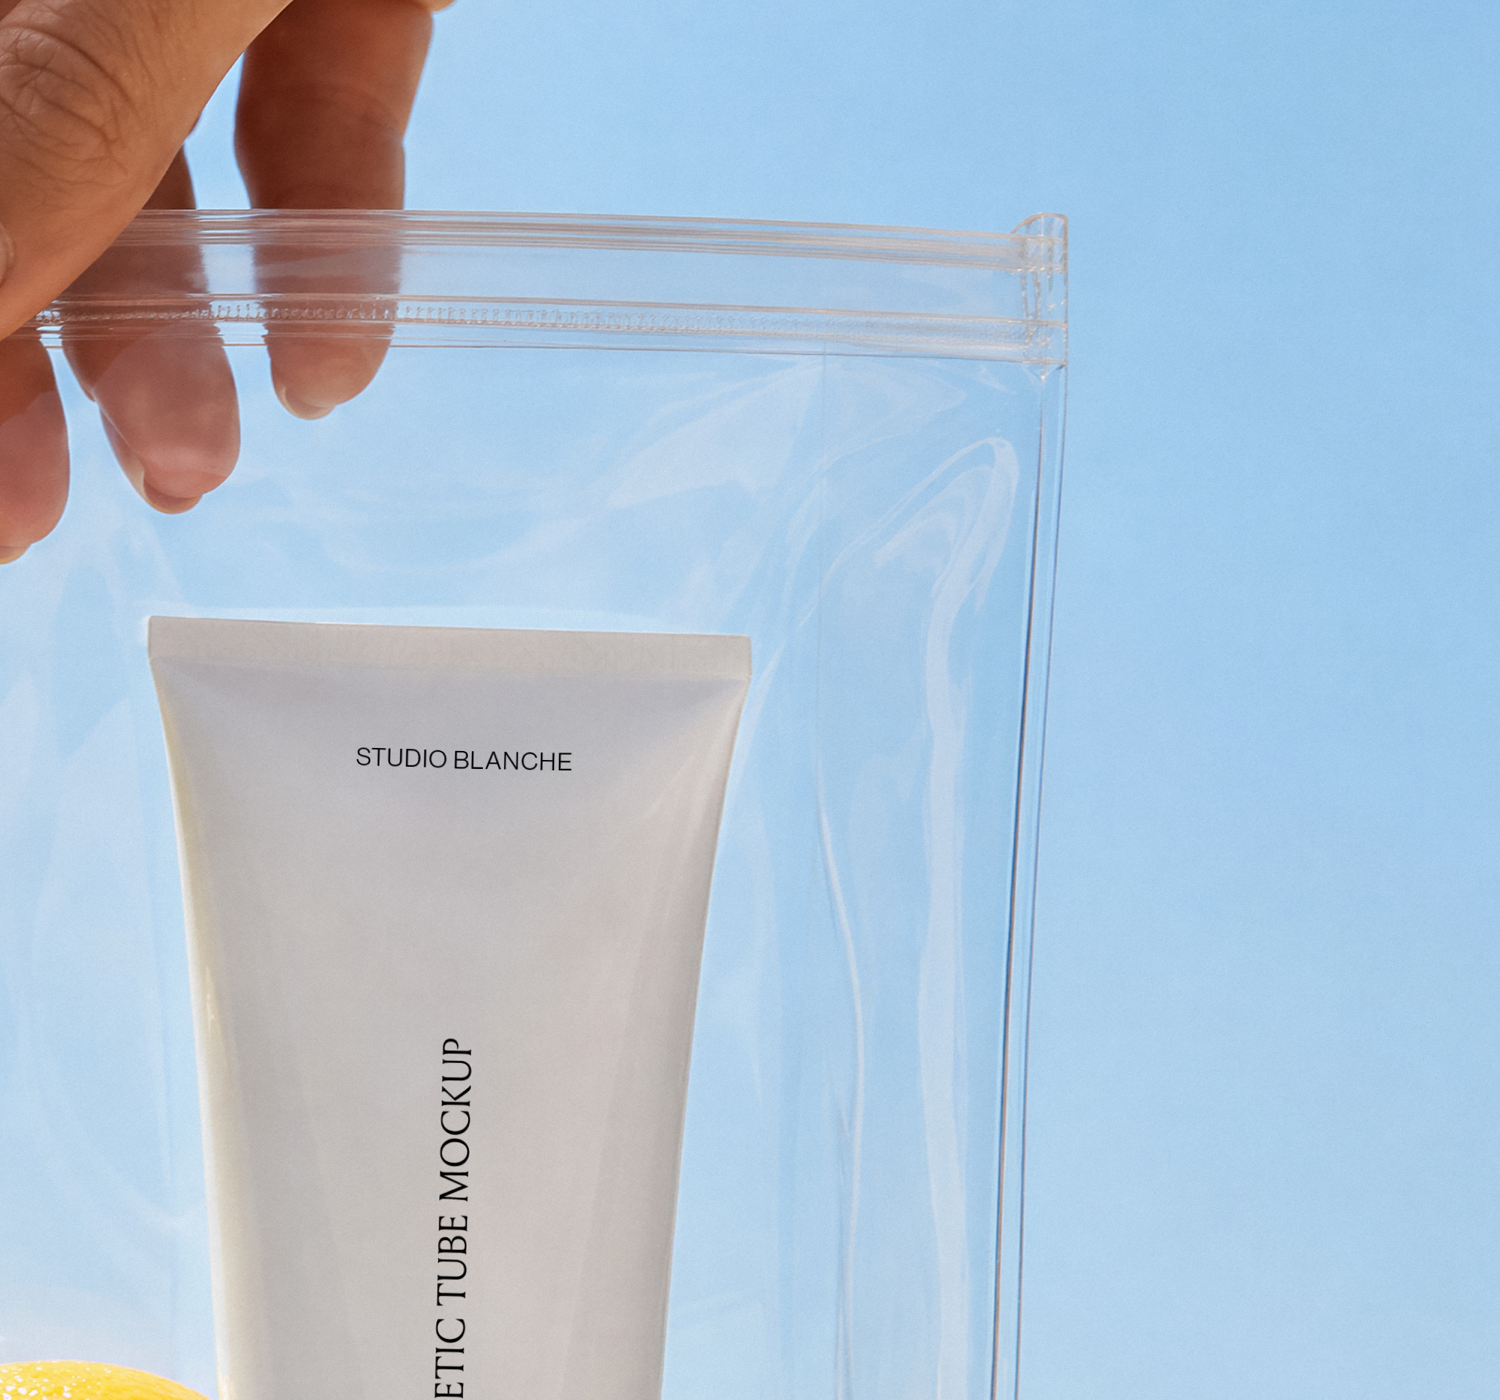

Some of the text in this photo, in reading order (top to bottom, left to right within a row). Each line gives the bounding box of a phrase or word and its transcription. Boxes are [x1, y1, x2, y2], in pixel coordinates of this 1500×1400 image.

[356, 747, 573, 771] STUDIO BLANCHE
[438, 1037, 473, 1203] MOCKUP
[435, 1214, 469, 1307] TUBE
